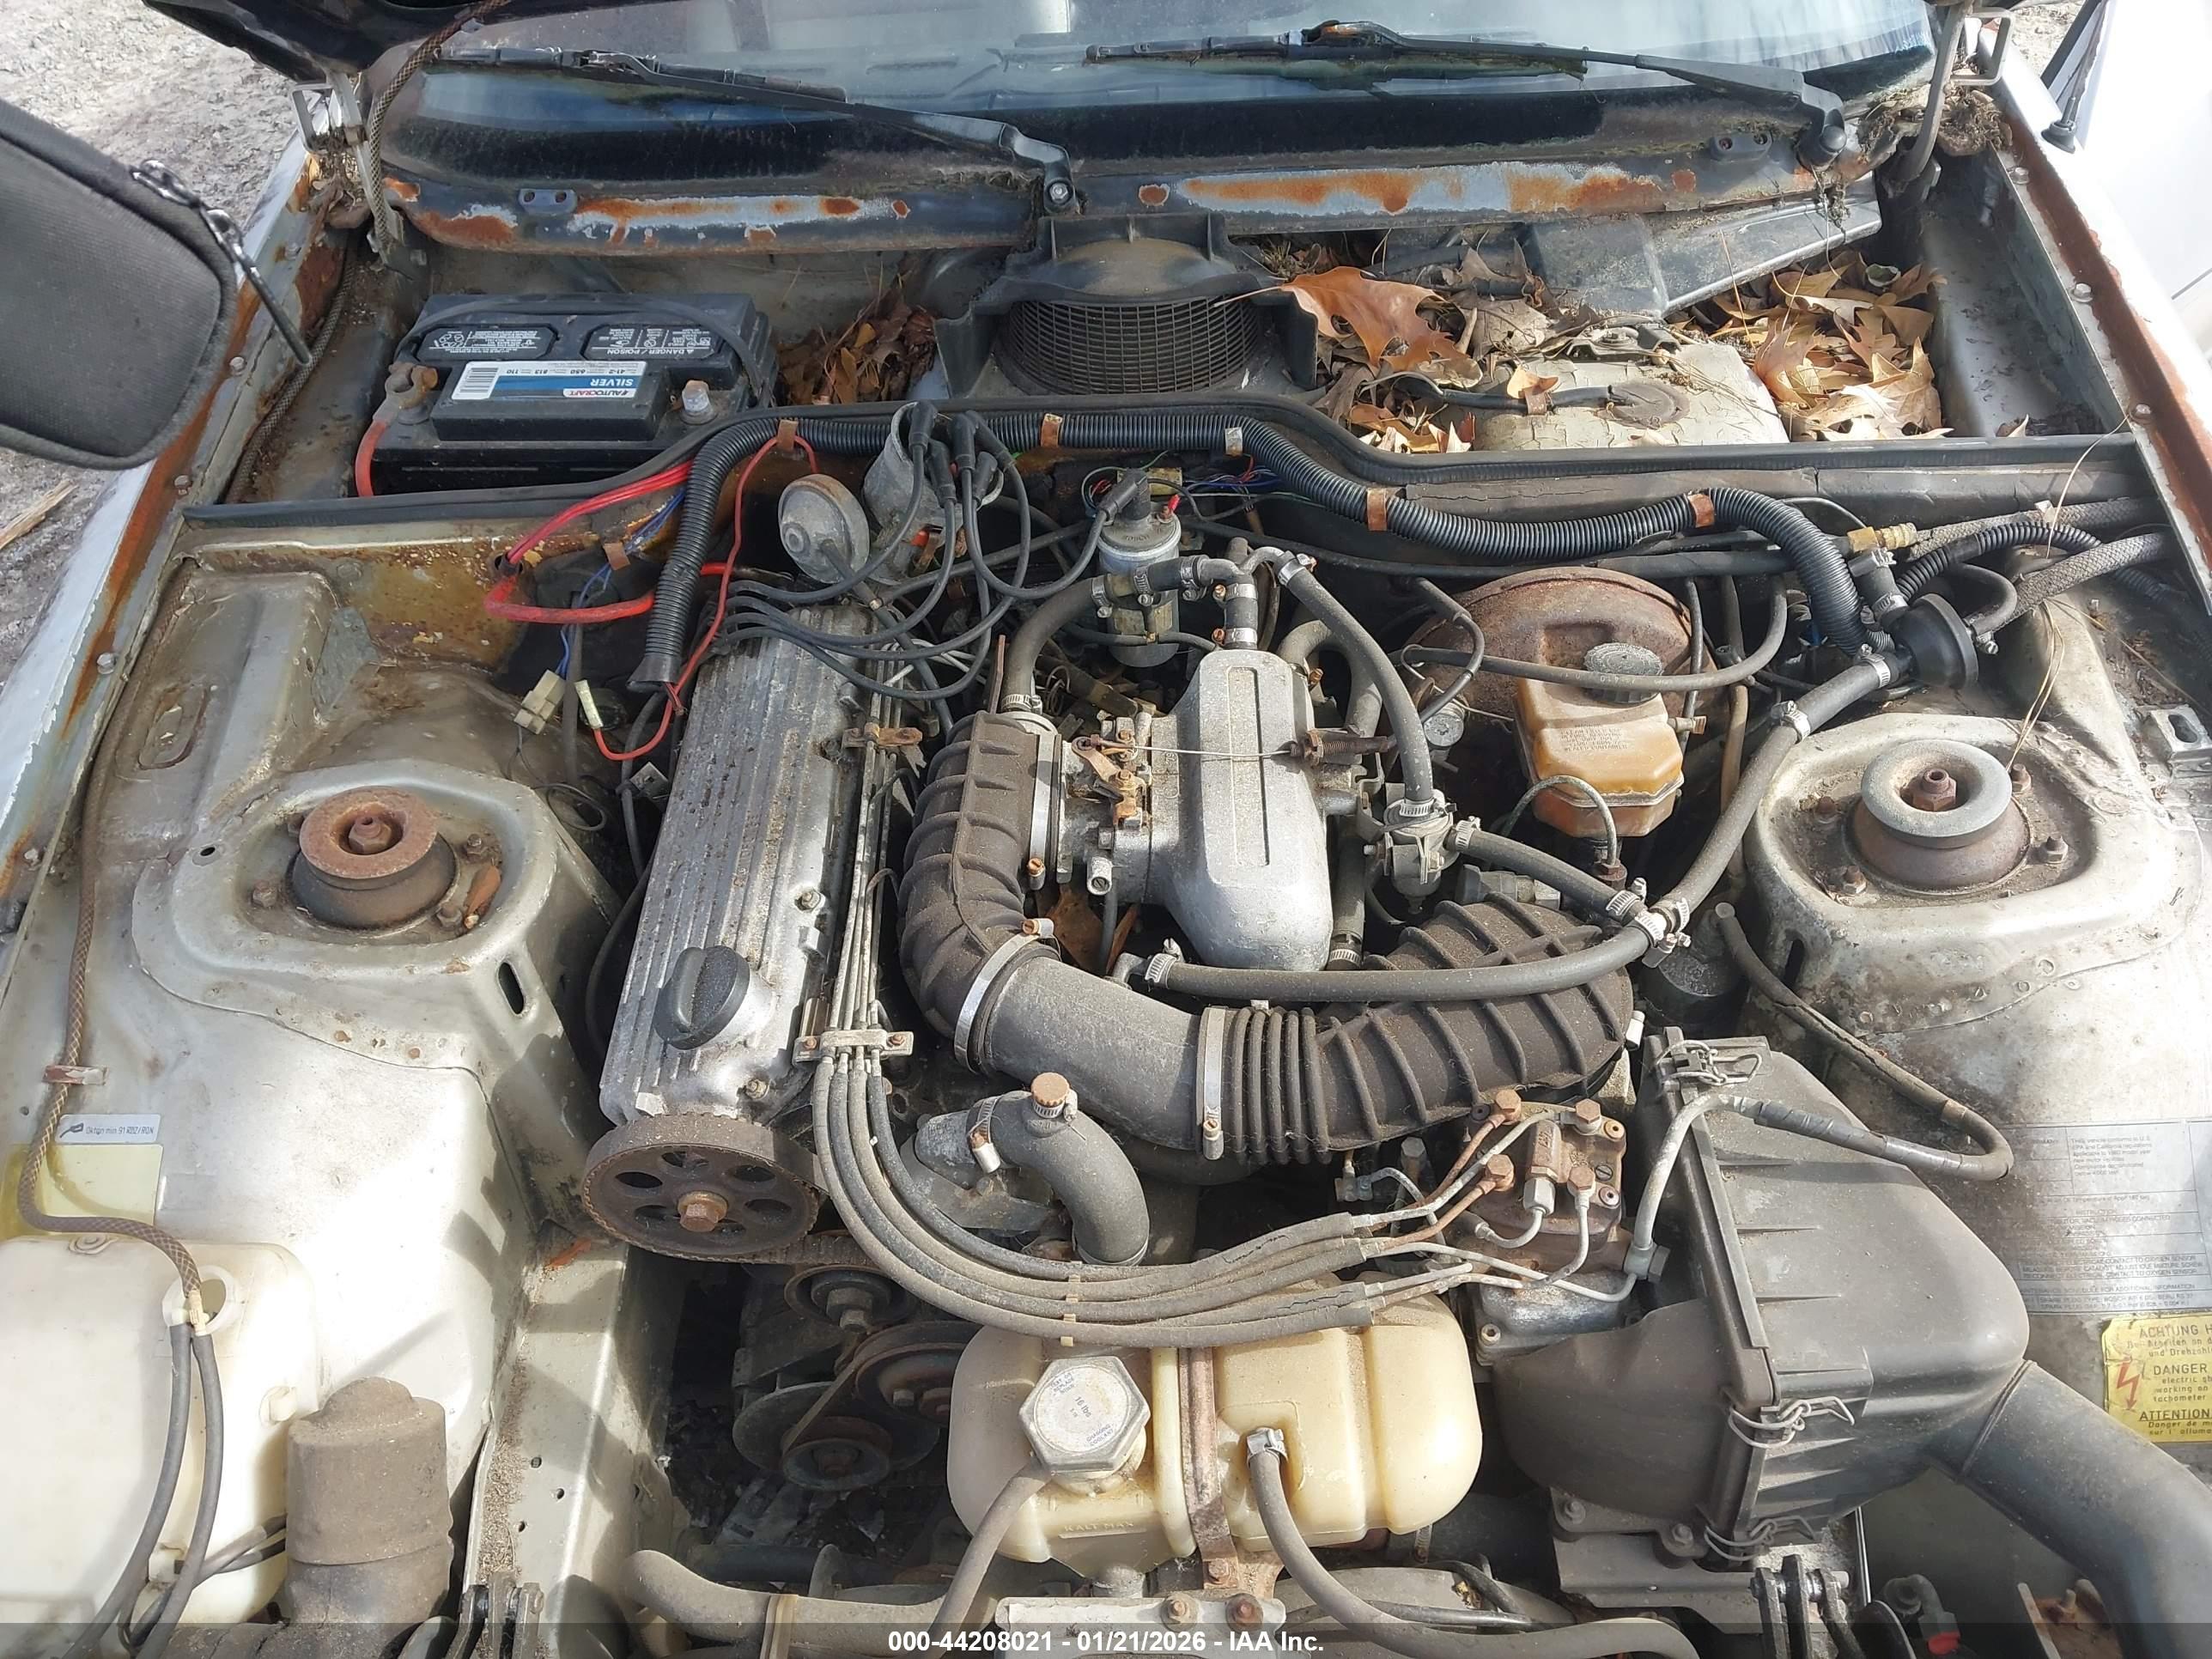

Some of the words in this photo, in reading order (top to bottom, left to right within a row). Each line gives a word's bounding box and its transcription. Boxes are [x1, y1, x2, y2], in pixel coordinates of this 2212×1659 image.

[590, 378, 634, 387] SILVER
[2139, 1324, 2199, 1339] ACHTUNG
[2170, 1346, 2212, 1357] Drehzahl
[2154, 1363, 2208, 1376] DANGER
[2162, 1376, 2197, 1384] electric
[2155, 1385, 2192, 1394] working
[2154, 1394, 2206, 1402] tachometer
[2139, 1408, 2210, 1421] ATTENTION
[2148, 1419, 2182, 1429] Danger
[2149, 1427, 2164, 1436] sur
